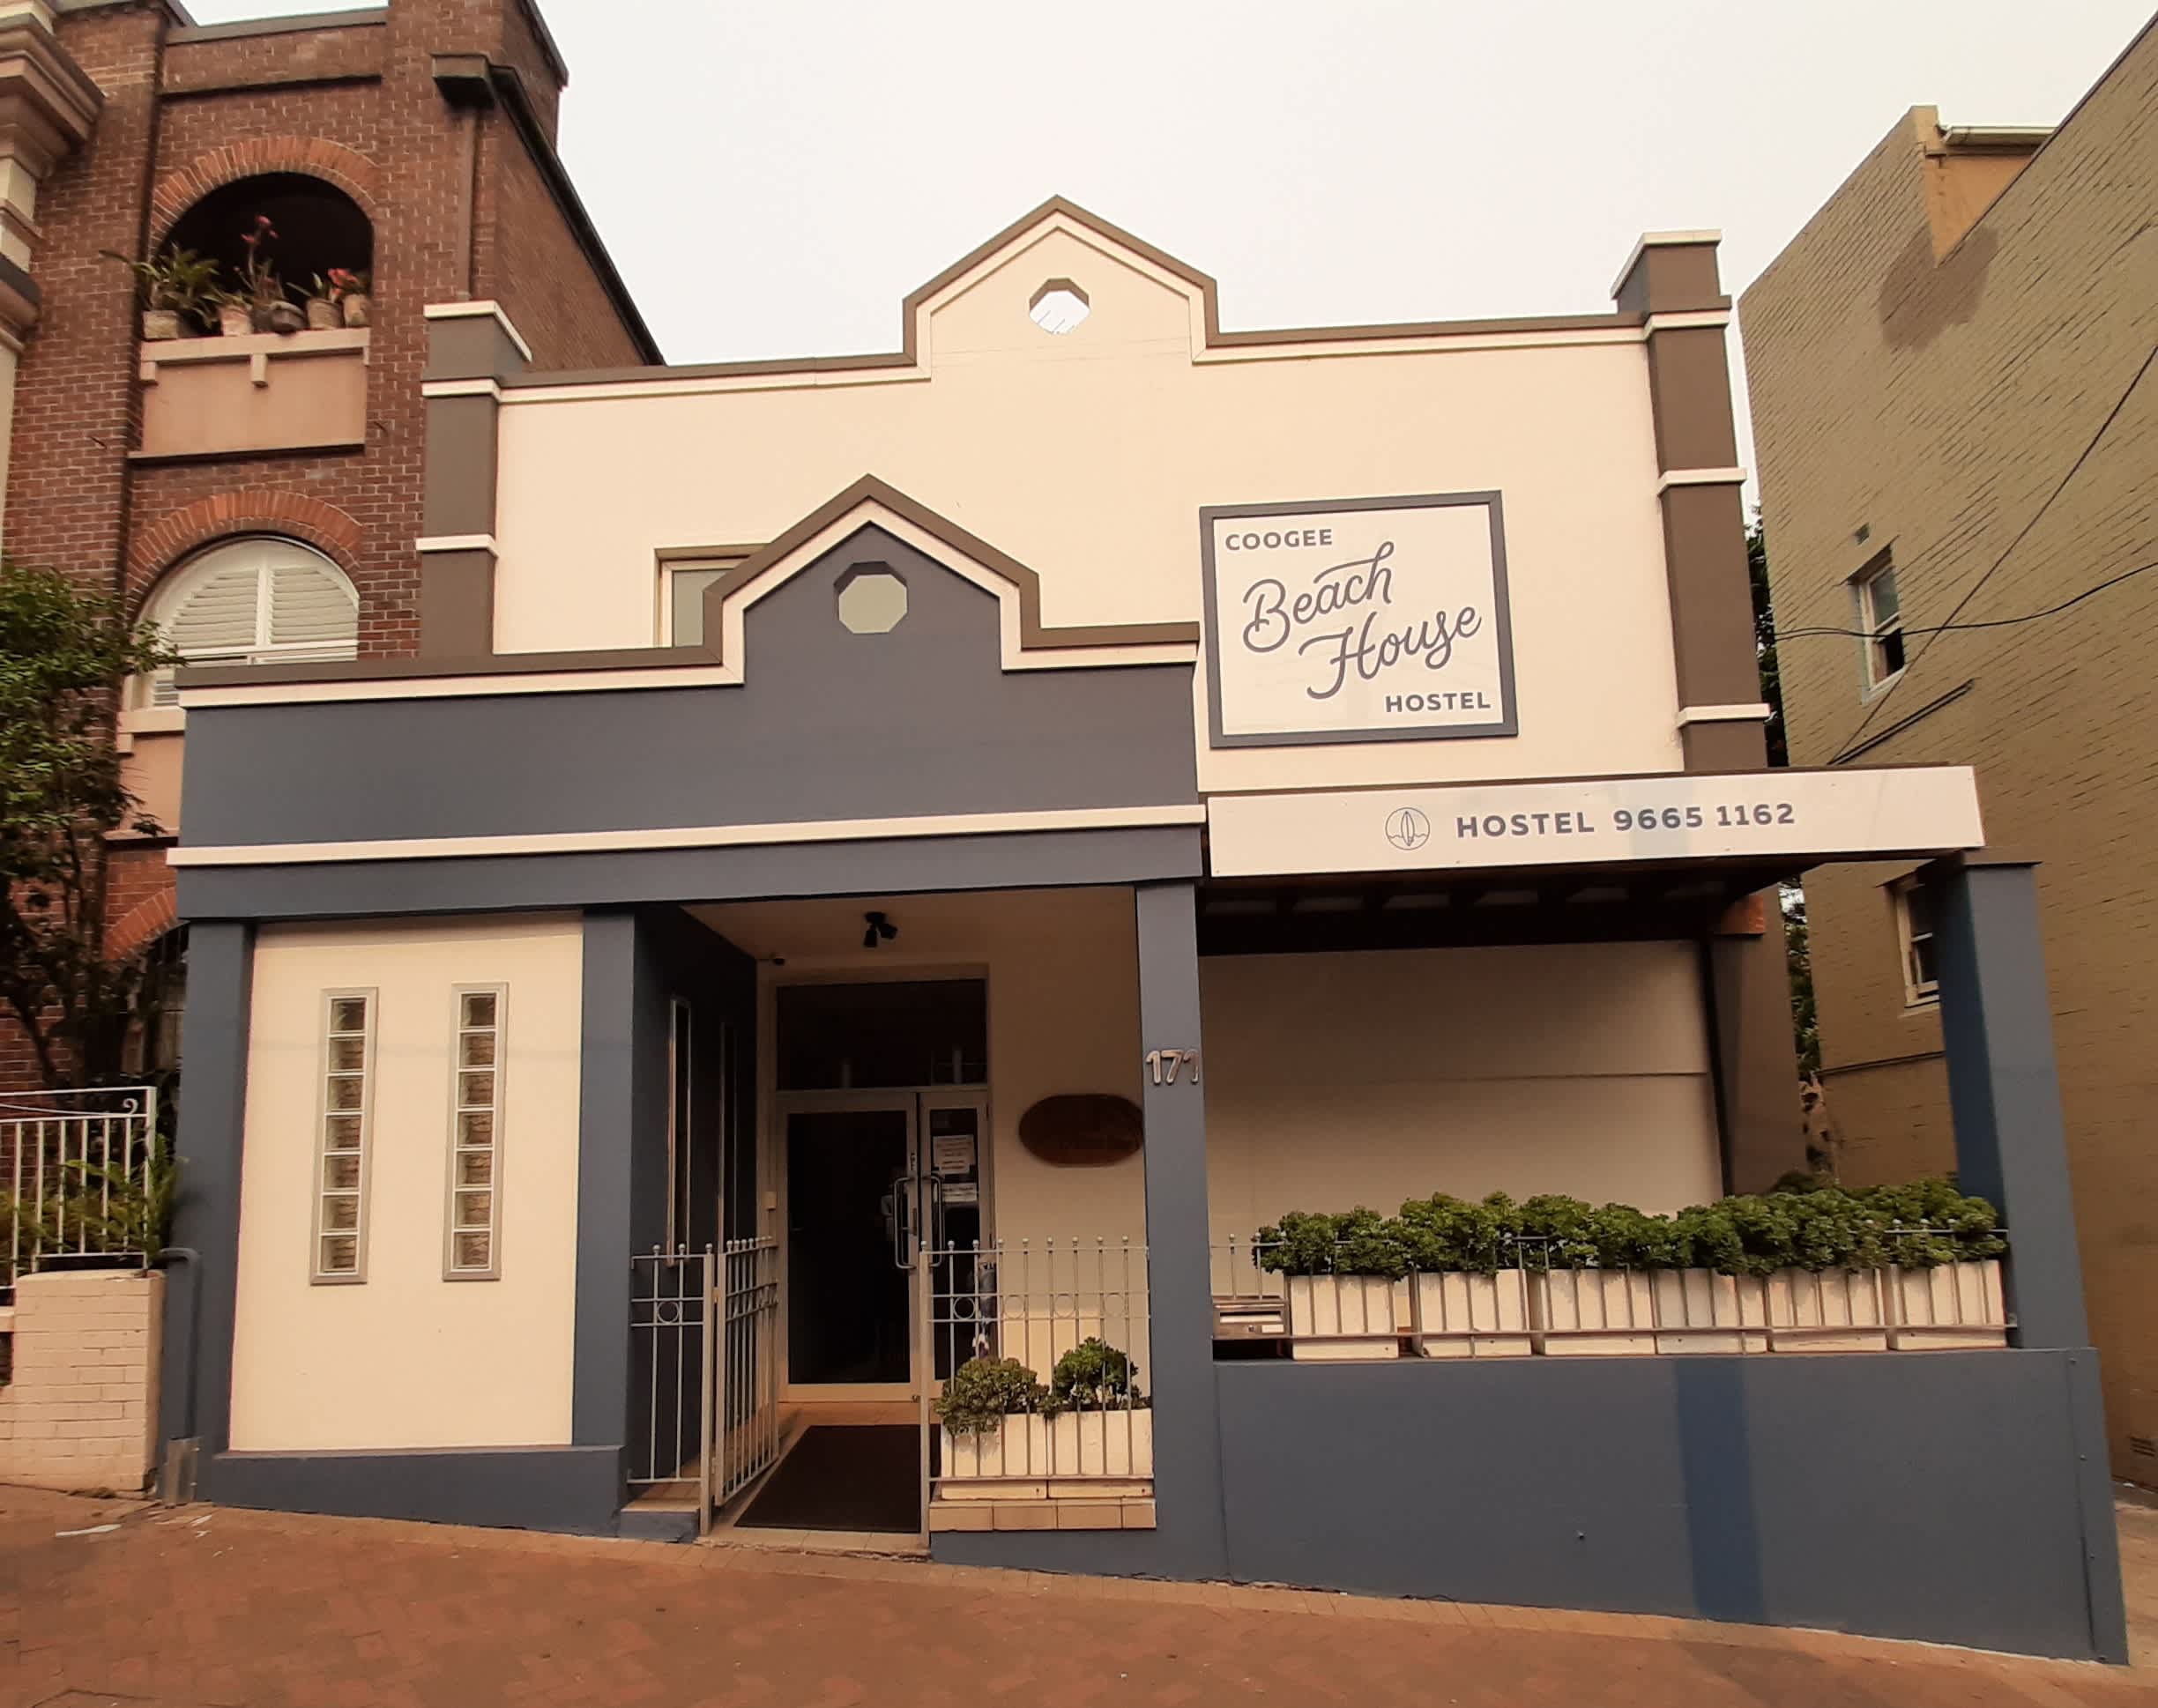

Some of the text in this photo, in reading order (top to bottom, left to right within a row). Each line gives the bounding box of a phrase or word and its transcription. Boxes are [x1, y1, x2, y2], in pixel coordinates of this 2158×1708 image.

[1225, 529, 1333, 551] COOGEE
[1243, 541, 1395, 653] Beach
[1298, 606, 1482, 700] House
[1386, 692, 1491, 713] HOSTEL
[1456, 803, 1795, 838] HOSTEL 9665 1162
[1145, 1049, 1200, 1084] 171
